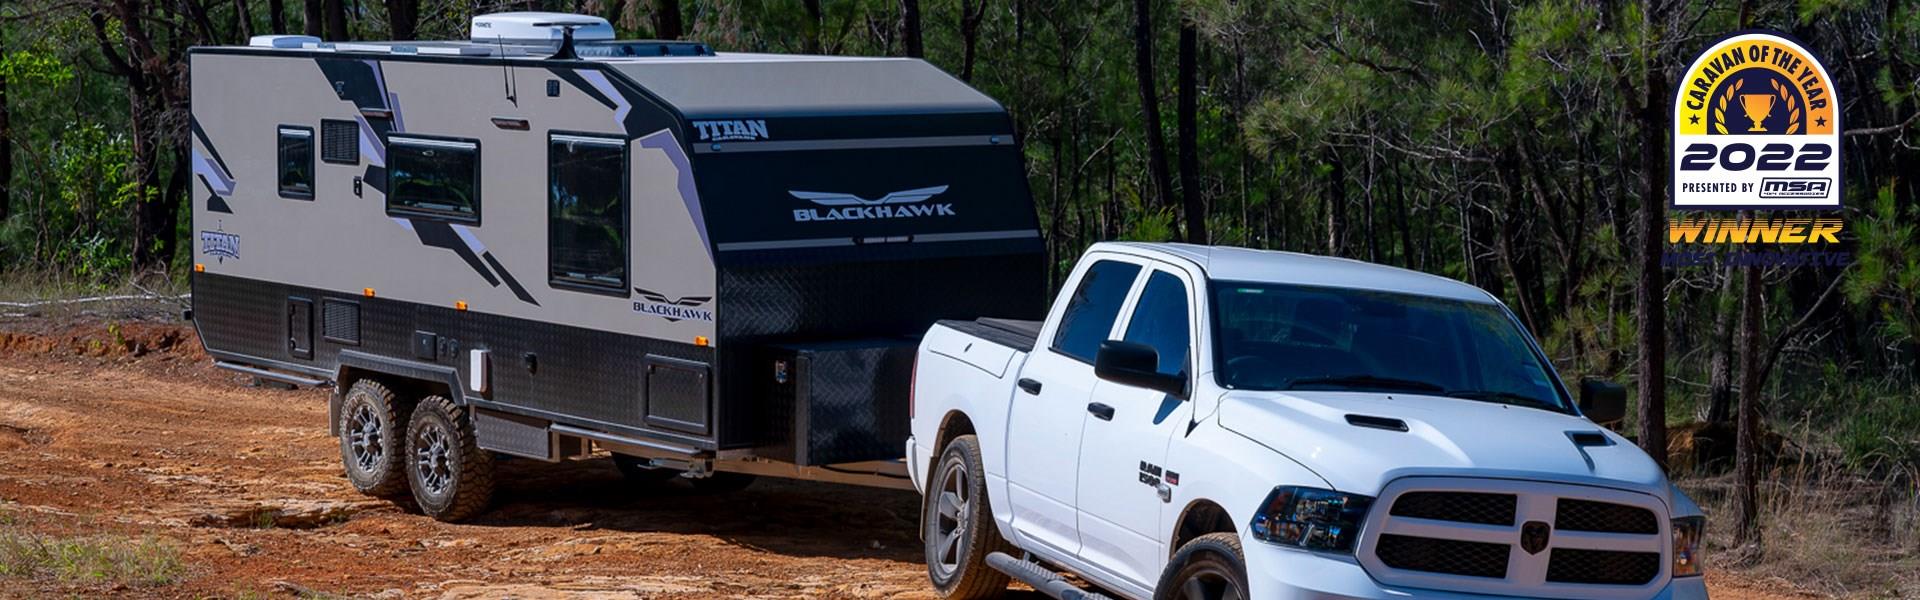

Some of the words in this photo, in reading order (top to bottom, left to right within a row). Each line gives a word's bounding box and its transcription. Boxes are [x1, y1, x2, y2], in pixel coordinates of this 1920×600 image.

[692, 119, 769, 140] TITAN
[793, 203, 956, 222] BLACKHAWK
[200, 230, 240, 260] TITAN
[633, 301, 713, 321] BLACKHAWK
[1140, 460, 1162, 478] RAM
